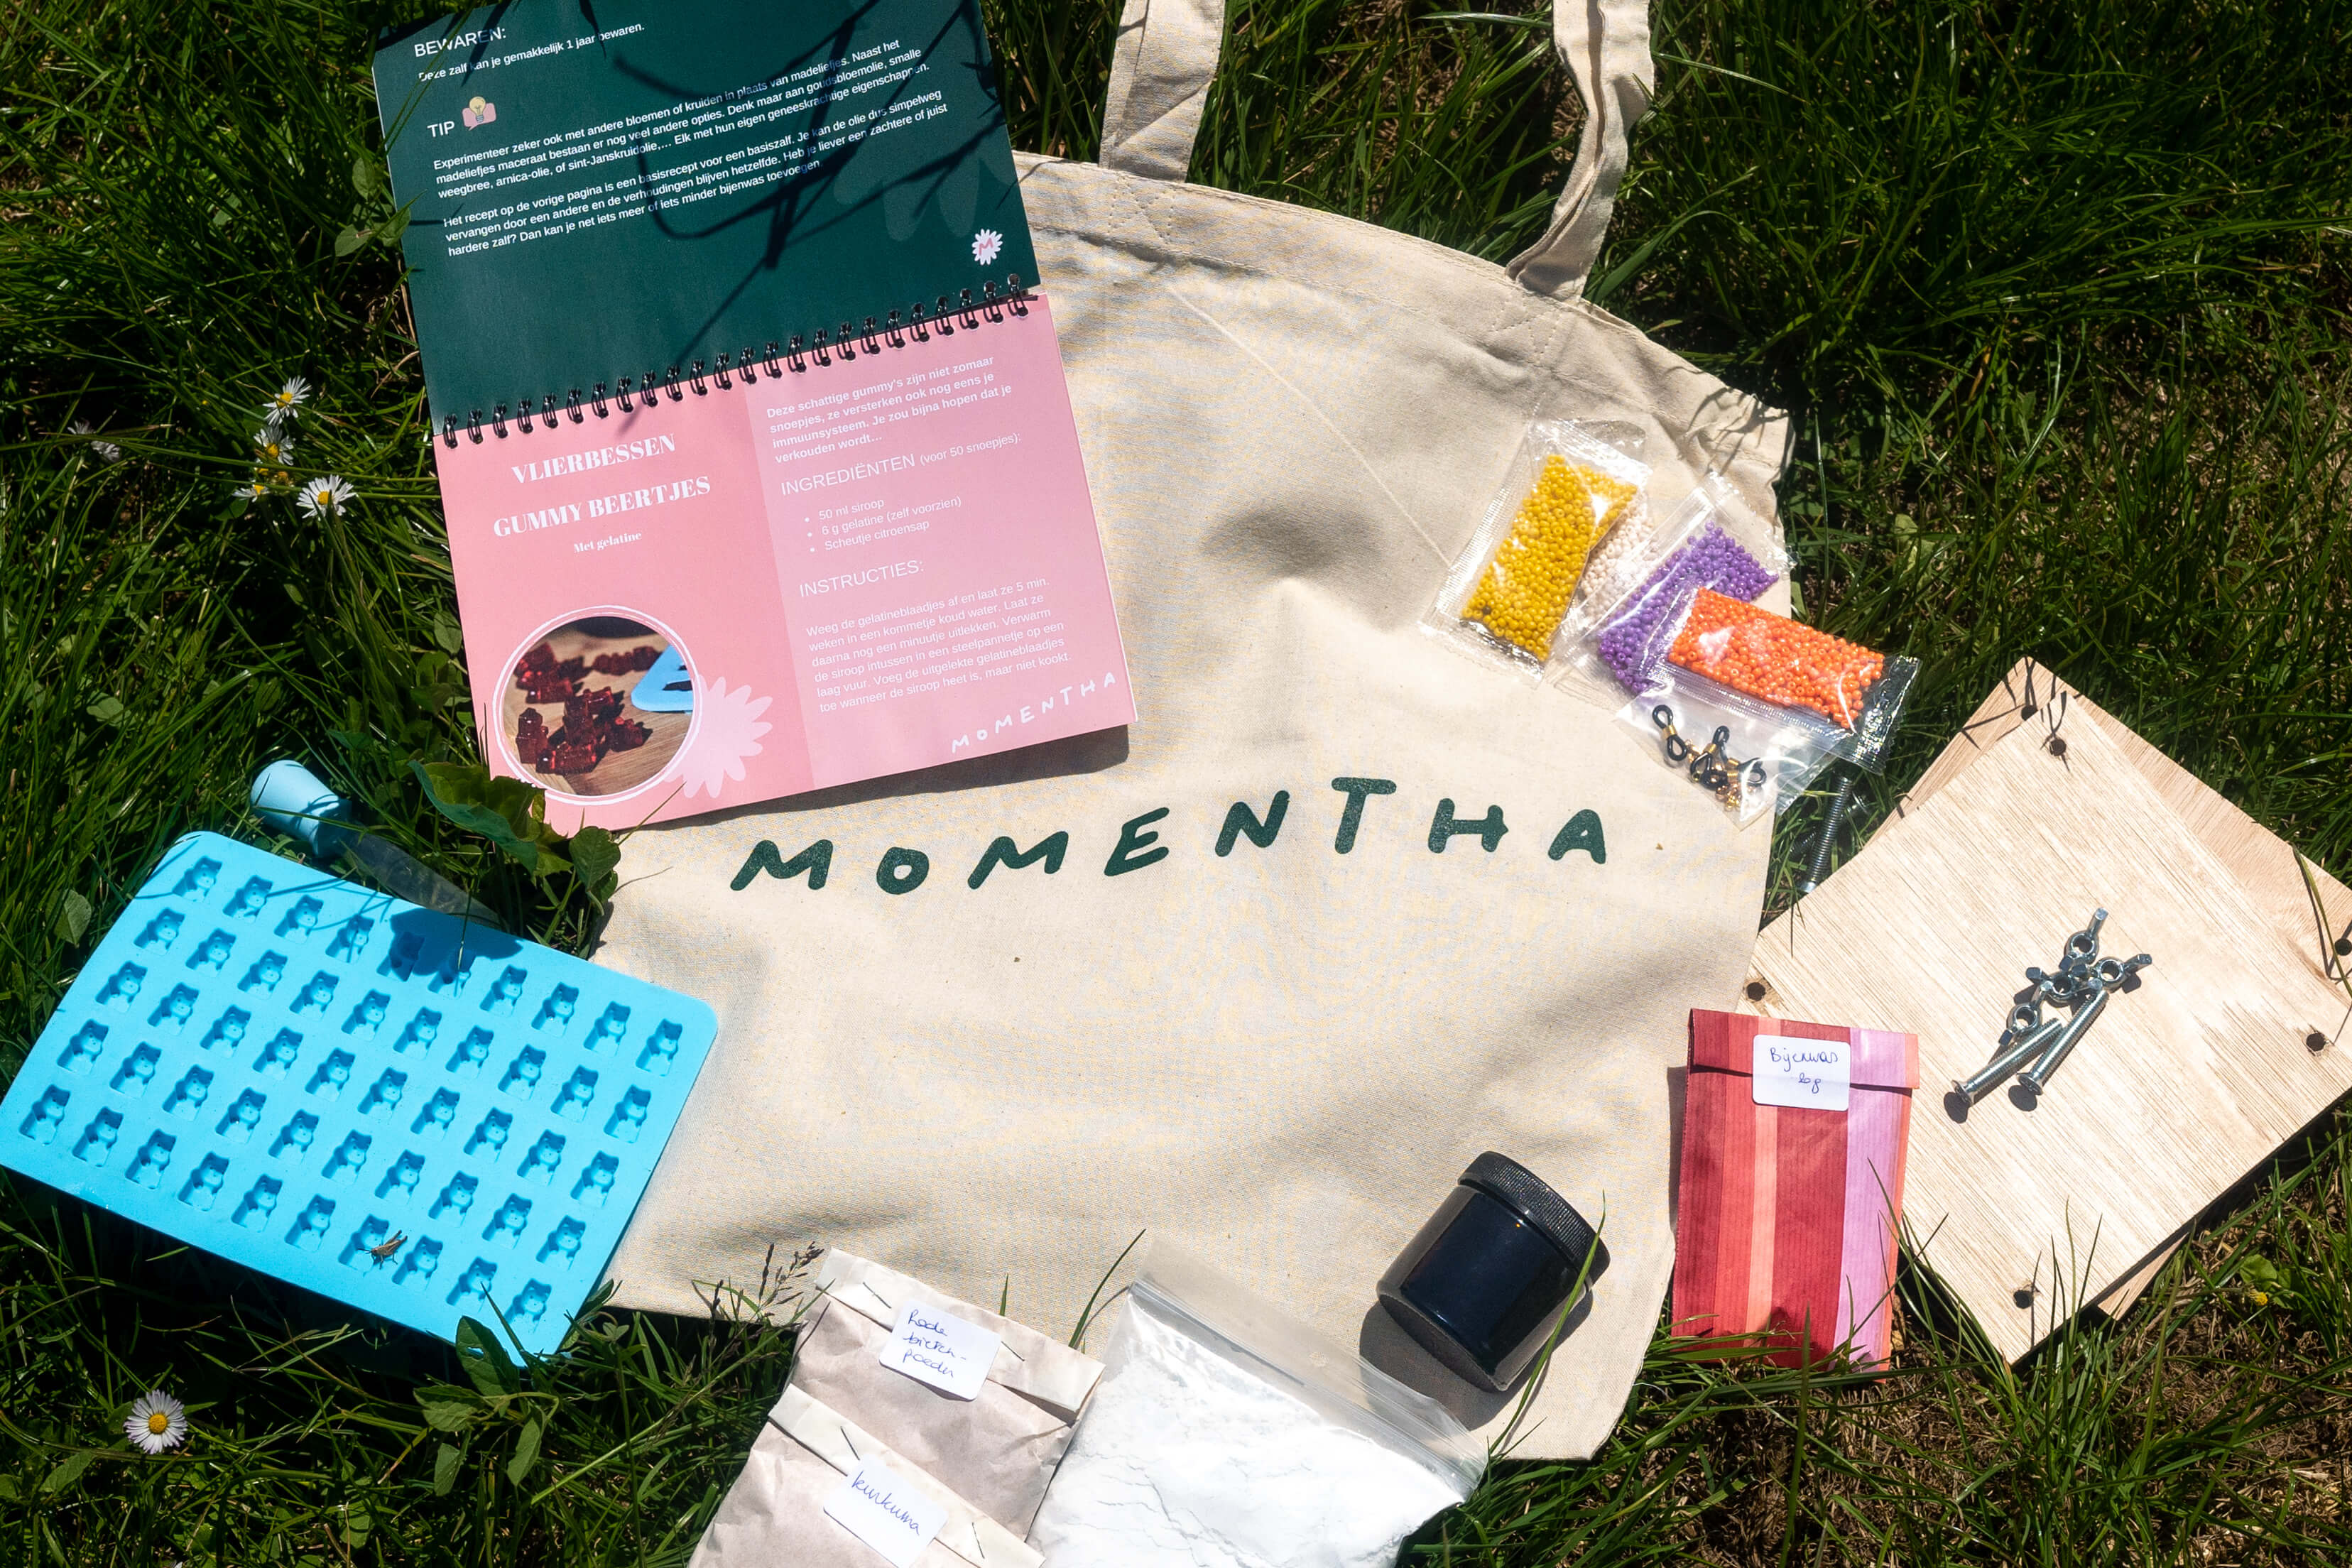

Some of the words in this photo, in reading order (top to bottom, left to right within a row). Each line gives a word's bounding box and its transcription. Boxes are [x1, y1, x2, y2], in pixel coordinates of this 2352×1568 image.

[414, 27, 506, 57] BEWAREN:
[448, 62, 467, 75] zalf
[503, 41, 564, 65] gemakkelijk
[575, 33, 595, 48] jaar
[427, 121, 454, 137] TIP
[433, 146, 509, 170] Experimenteer
[511, 139, 540, 153] zeker
[543, 133, 562, 146] ook
[565, 128, 585, 141] met
[587, 121, 623, 135] andere
[625, 109, 670, 126] bloemen
[684, 94, 722, 111] kruiden
[769, 75, 788, 87] van
[790, 58, 850, 82] madeliefjes.
[851, 44, 882, 62] Naast
[882, 39, 900, 52] het
[436, 165, 495, 184] madeliefjes
[497, 152, 547, 170] maceraat
[548, 143, 591, 159] bestaan
[606, 134, 626, 146] nog
[628, 126, 650, 141] veel
[653, 119, 688, 134] andere
[690, 110, 725, 125] opties.
[726, 99, 754, 115] Denk
[756, 92, 783, 107] maar
[785, 87, 805, 99] aan
[806, 61, 887, 94] goudsbloemolie,
[888, 48, 921, 65] smalle
[437, 181, 493, 198] weegbree,
[496, 166, 552, 186] arnica-olie,
[674, 132, 691, 144] Elk
[692, 126, 714, 140] met
[714, 122, 735, 134] hun
[737, 114, 766, 128] eigen
[767, 88, 849, 121] geneeskrachtige
[443, 215, 462, 227] Het
[464, 208, 499, 222] recept
[531, 195, 564, 208] vorige
[567, 186, 602, 203] pagina
[616, 178, 636, 188] een
[638, 161, 699, 184] basisrecept
[699, 155, 723, 168] voor
[725, 150, 745, 161] een
[746, 134, 795, 156] basiszalf.
[848, 114, 866, 126] olie
[888, 89, 942, 113] simpelweg
[445, 223, 501, 241] vervangen
[503, 217, 527, 229] door
[530, 212, 550, 223] een
[552, 205, 589, 219] andere
[622, 179, 694, 202] verhoudingen
[695, 170, 729, 185] blijven
[730, 156, 780, 175] hetzelfde.
[783, 147, 804, 161] Heb
[817, 136, 845, 151] liever
[869, 116, 912, 136] zachtere
[925, 103, 947, 119] juist
[447, 241, 489, 256] hardere
[491, 234, 516, 247] zalf?
[519, 229, 541, 241] Dan
[543, 224, 563, 236] kan
[577, 216, 595, 228] net
[597, 213, 616, 224] iets
[618, 205, 645, 219] meer
[659, 197, 679, 209] iets
[681, 187, 717, 204] minder
[719, 175, 764, 195] bijenwas
[767, 405, 794, 418] Deze
[797, 393, 849, 410] schattige
[852, 379, 903, 400] gummy's
[905, 373, 925, 385] zijn
[928, 366, 950, 379] niet
[952, 356, 993, 373] zomaar
[770, 415, 824, 432] snoepjes,
[842, 396, 902, 415] versterken
[905, 388, 926, 401] ook
[929, 383, 950, 395] nog
[954, 376, 981, 388] eens
[773, 420, 869, 447] immuunsysteem.
[888, 410, 908, 421] zou
[911, 403, 940, 415] bijna
[942, 393, 977, 408] hopen
[980, 387, 999, 398] dat
[511, 433, 676, 484] VLIERBESSEN
[775, 443, 835, 462] verkouden
[781, 453, 915, 495] INGREDIËNTEN
[920, 450, 947, 465] (voor
[949, 445, 963, 456] 50
[966, 432, 1020, 452] snoepjes):
[493, 502, 582, 537] GUMMY
[589, 476, 711, 518] BEERTJES
[819, 508, 832, 519] 50
[835, 505, 848, 516] ml
[851, 499, 883, 512] siroop
[822, 526, 829, 535] 6
[841, 515, 883, 533] gelatine
[886, 506, 908, 522] (zelf
[911, 496, 961, 514] voorzien)
[824, 533, 871, 550] Scheutje
[874, 521, 929, 539] citroensap
[573, 541, 595, 553] Met
[597, 532, 642, 551] gelatine
[800, 560, 923, 597] INSTRUCTIES:
[805, 624, 838, 636] Weeg
[858, 601, 944, 628] gelatineblaadjes
[977, 588, 998, 600] laat
[1026, 577, 1049, 589] min.
[808, 638, 844, 650] weken
[859, 631, 880, 641] een
[883, 617, 935, 636] kommetje
[938, 609, 964, 624] koud
[967, 604, 1000, 617] water.
[1004, 597, 1028, 609] Laat
[812, 653, 850, 666] daarna
[853, 648, 873, 658] nog
[876, 642, 896, 653] een
[899, 631, 944, 648] minuutje
[948, 621, 998, 638] uitlekken.
[1001, 609, 1050, 625] Verwarm
[831, 665, 864, 678] siroop
[867, 655, 913, 670] intussen
[928, 647, 949, 658] een
[952, 631, 1023, 653] steelpannetje
[1043, 622, 1063, 633] een
[817, 686, 840, 697] laag
[842, 680, 870, 691] vuur.
[873, 673, 902, 685] Voeg
[922, 658, 973, 675] uitgelekte
[976, 638, 1064, 665] gelatineblaadjes
[820, 702, 837, 712] toe
[839, 692, 886, 707] wanneer
[906, 681, 940, 694] siroop
[942, 674, 967, 687] heet
[985, 665, 1011, 677] maar
[1016, 659, 1036, 670] niet
[1038, 652, 1069, 666] kookt.
[952, 672, 1116, 753] MOMENTHA
[731, 778, 1606, 895] MOMENTHA
[908, 1310, 948, 1336] Rode
[851, 1470, 920, 1535] kurkuma
